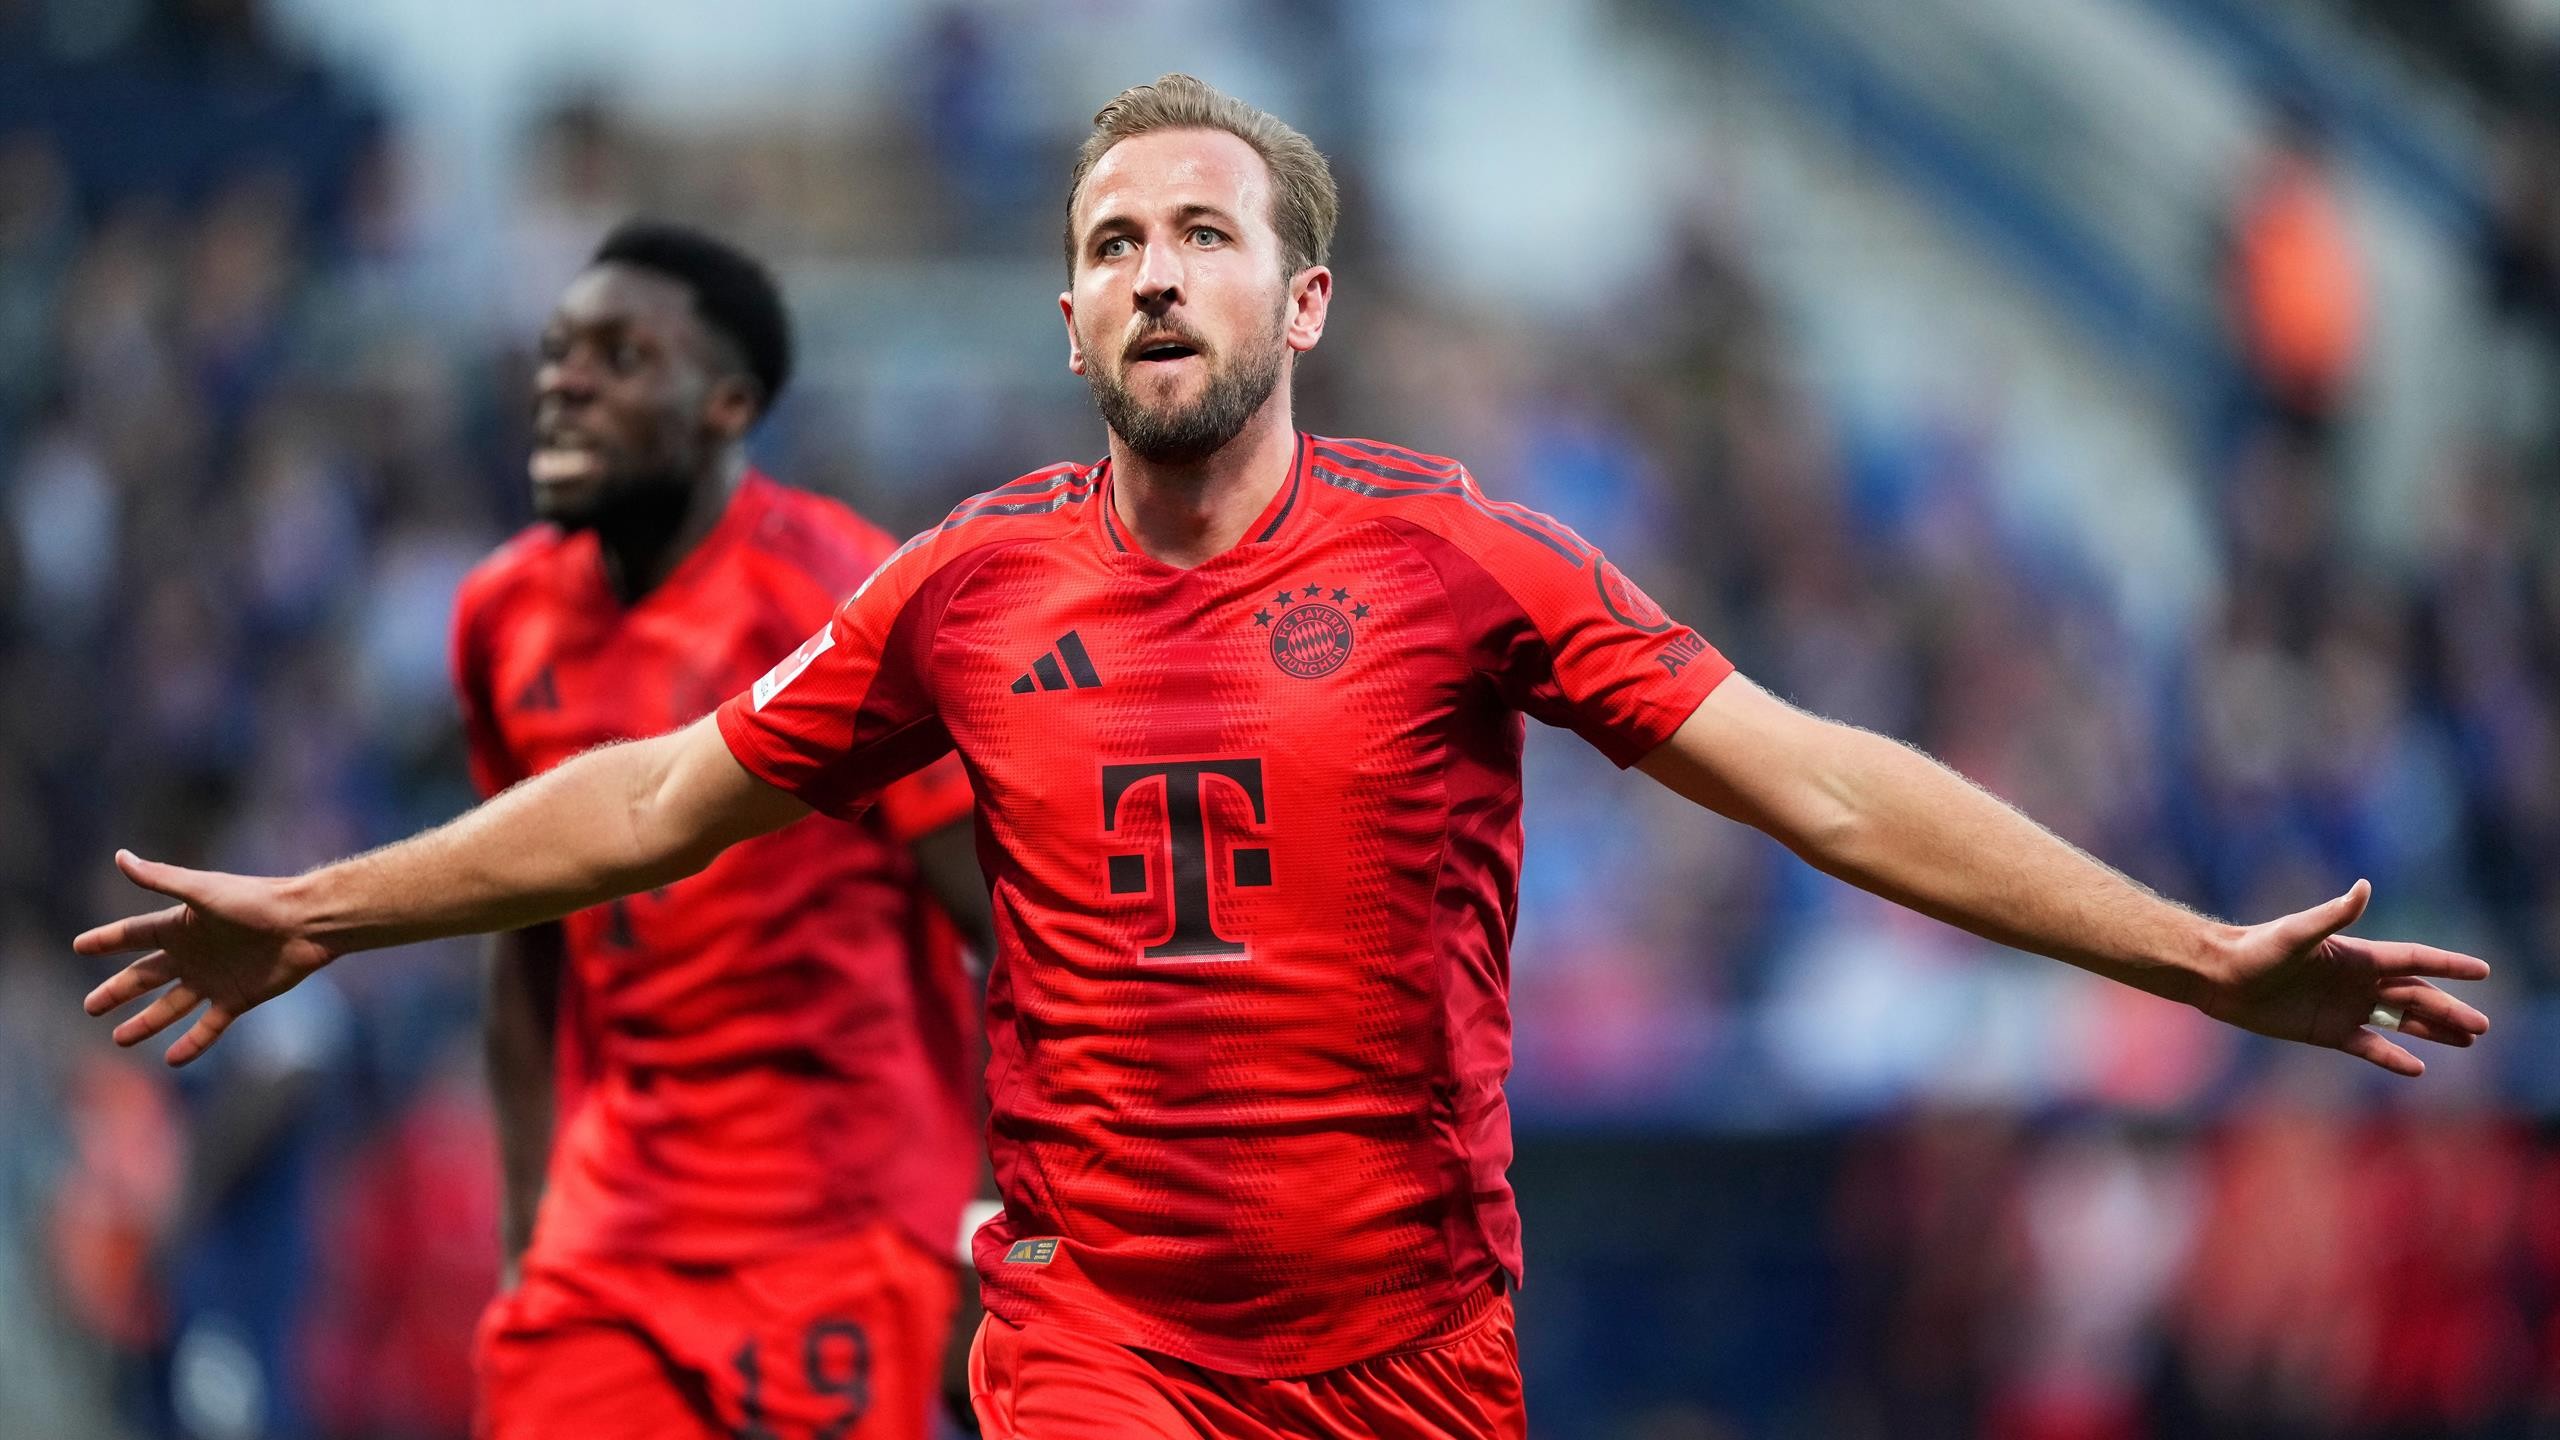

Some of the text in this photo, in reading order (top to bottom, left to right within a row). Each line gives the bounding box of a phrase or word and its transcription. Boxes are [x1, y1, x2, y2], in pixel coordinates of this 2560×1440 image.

[1278, 609, 1345, 638] FC BAYERN
[1102, 758, 1268, 958] T
[733, 1318, 870, 1440] 19
